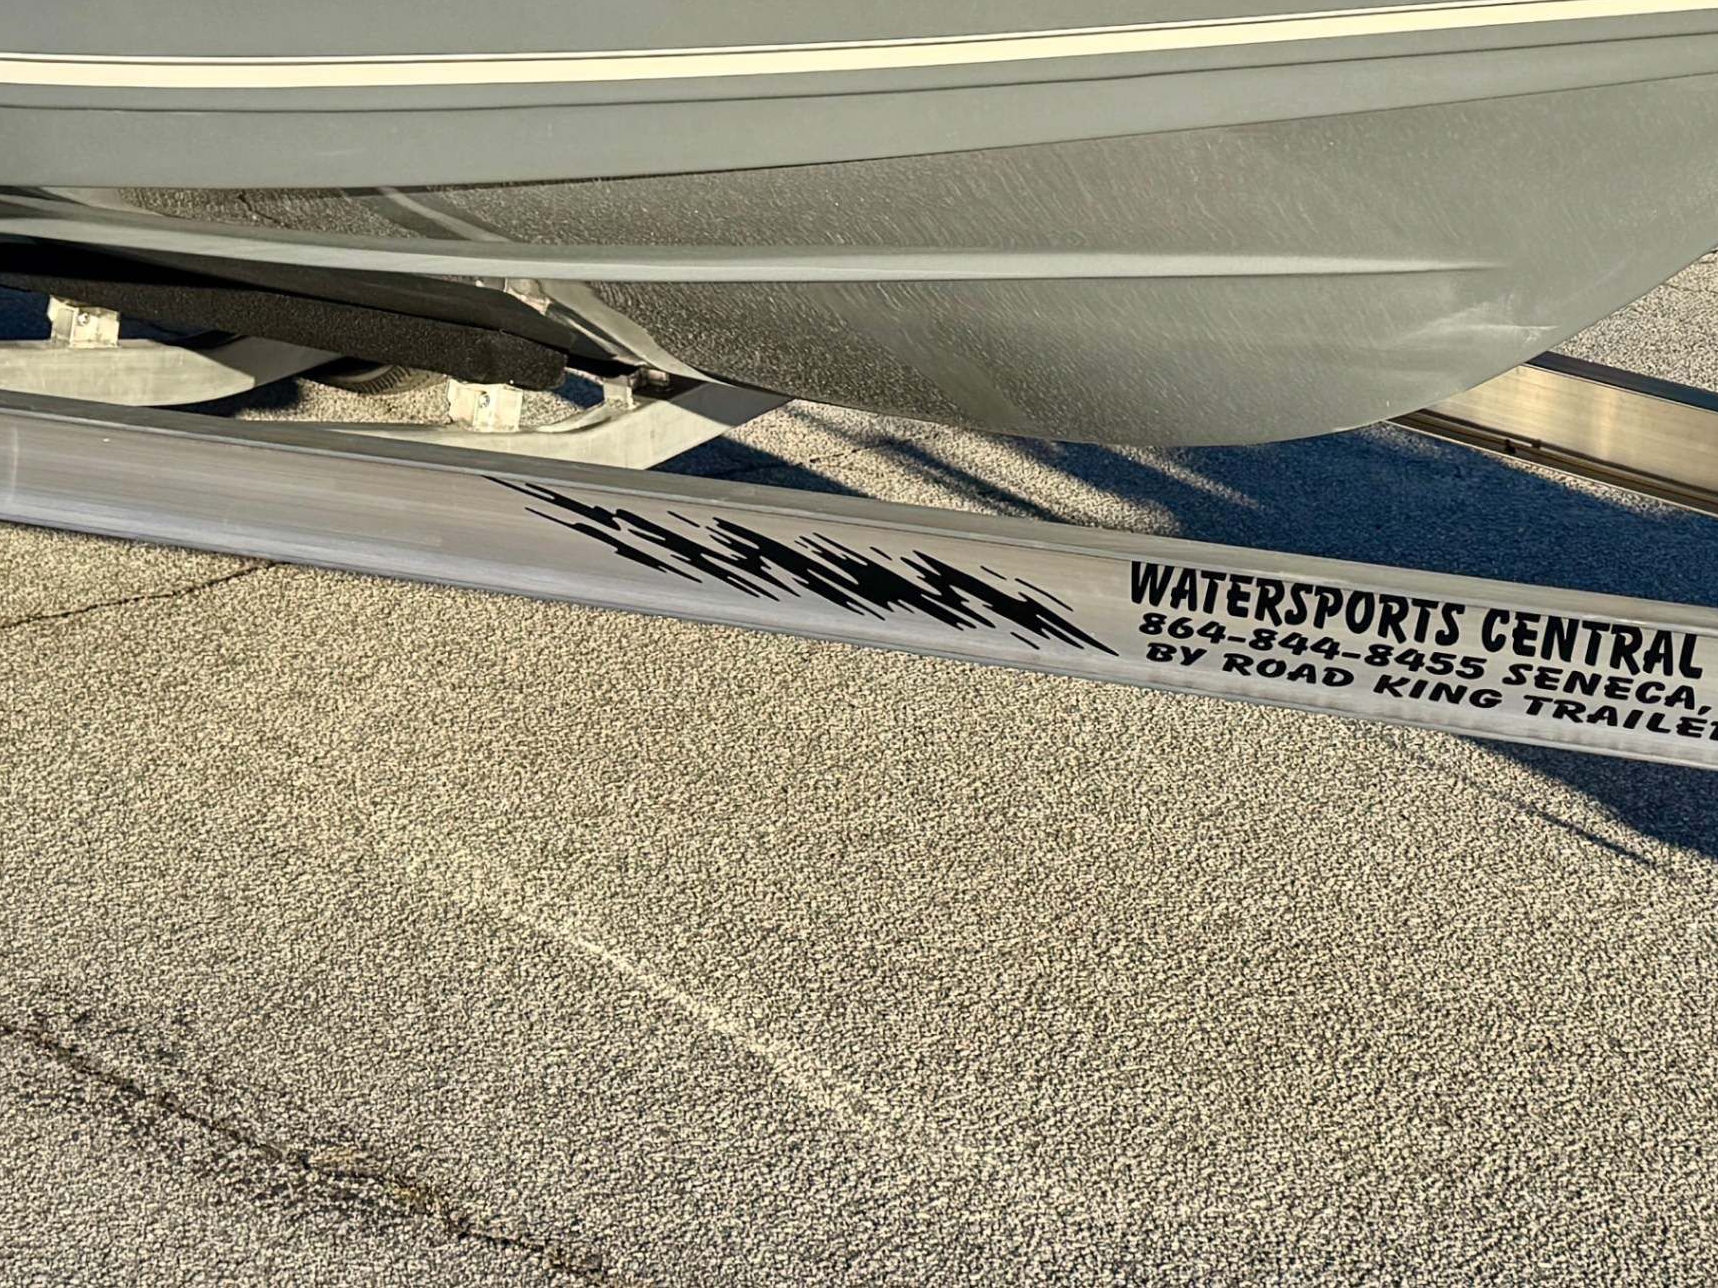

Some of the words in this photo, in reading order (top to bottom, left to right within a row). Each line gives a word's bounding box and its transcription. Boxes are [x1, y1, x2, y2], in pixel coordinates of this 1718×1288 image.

[1131, 561, 1466, 647] WATERSPORTS
[1481, 608, 1704, 680] CENTRAL
[1138, 612, 1488, 680] 864-844-8455
[1502, 663, 1713, 716] SENECA,
[1146, 642, 1207, 666] BY
[1222, 652, 1354, 687] ROAD
[1373, 675, 1503, 709] KING
